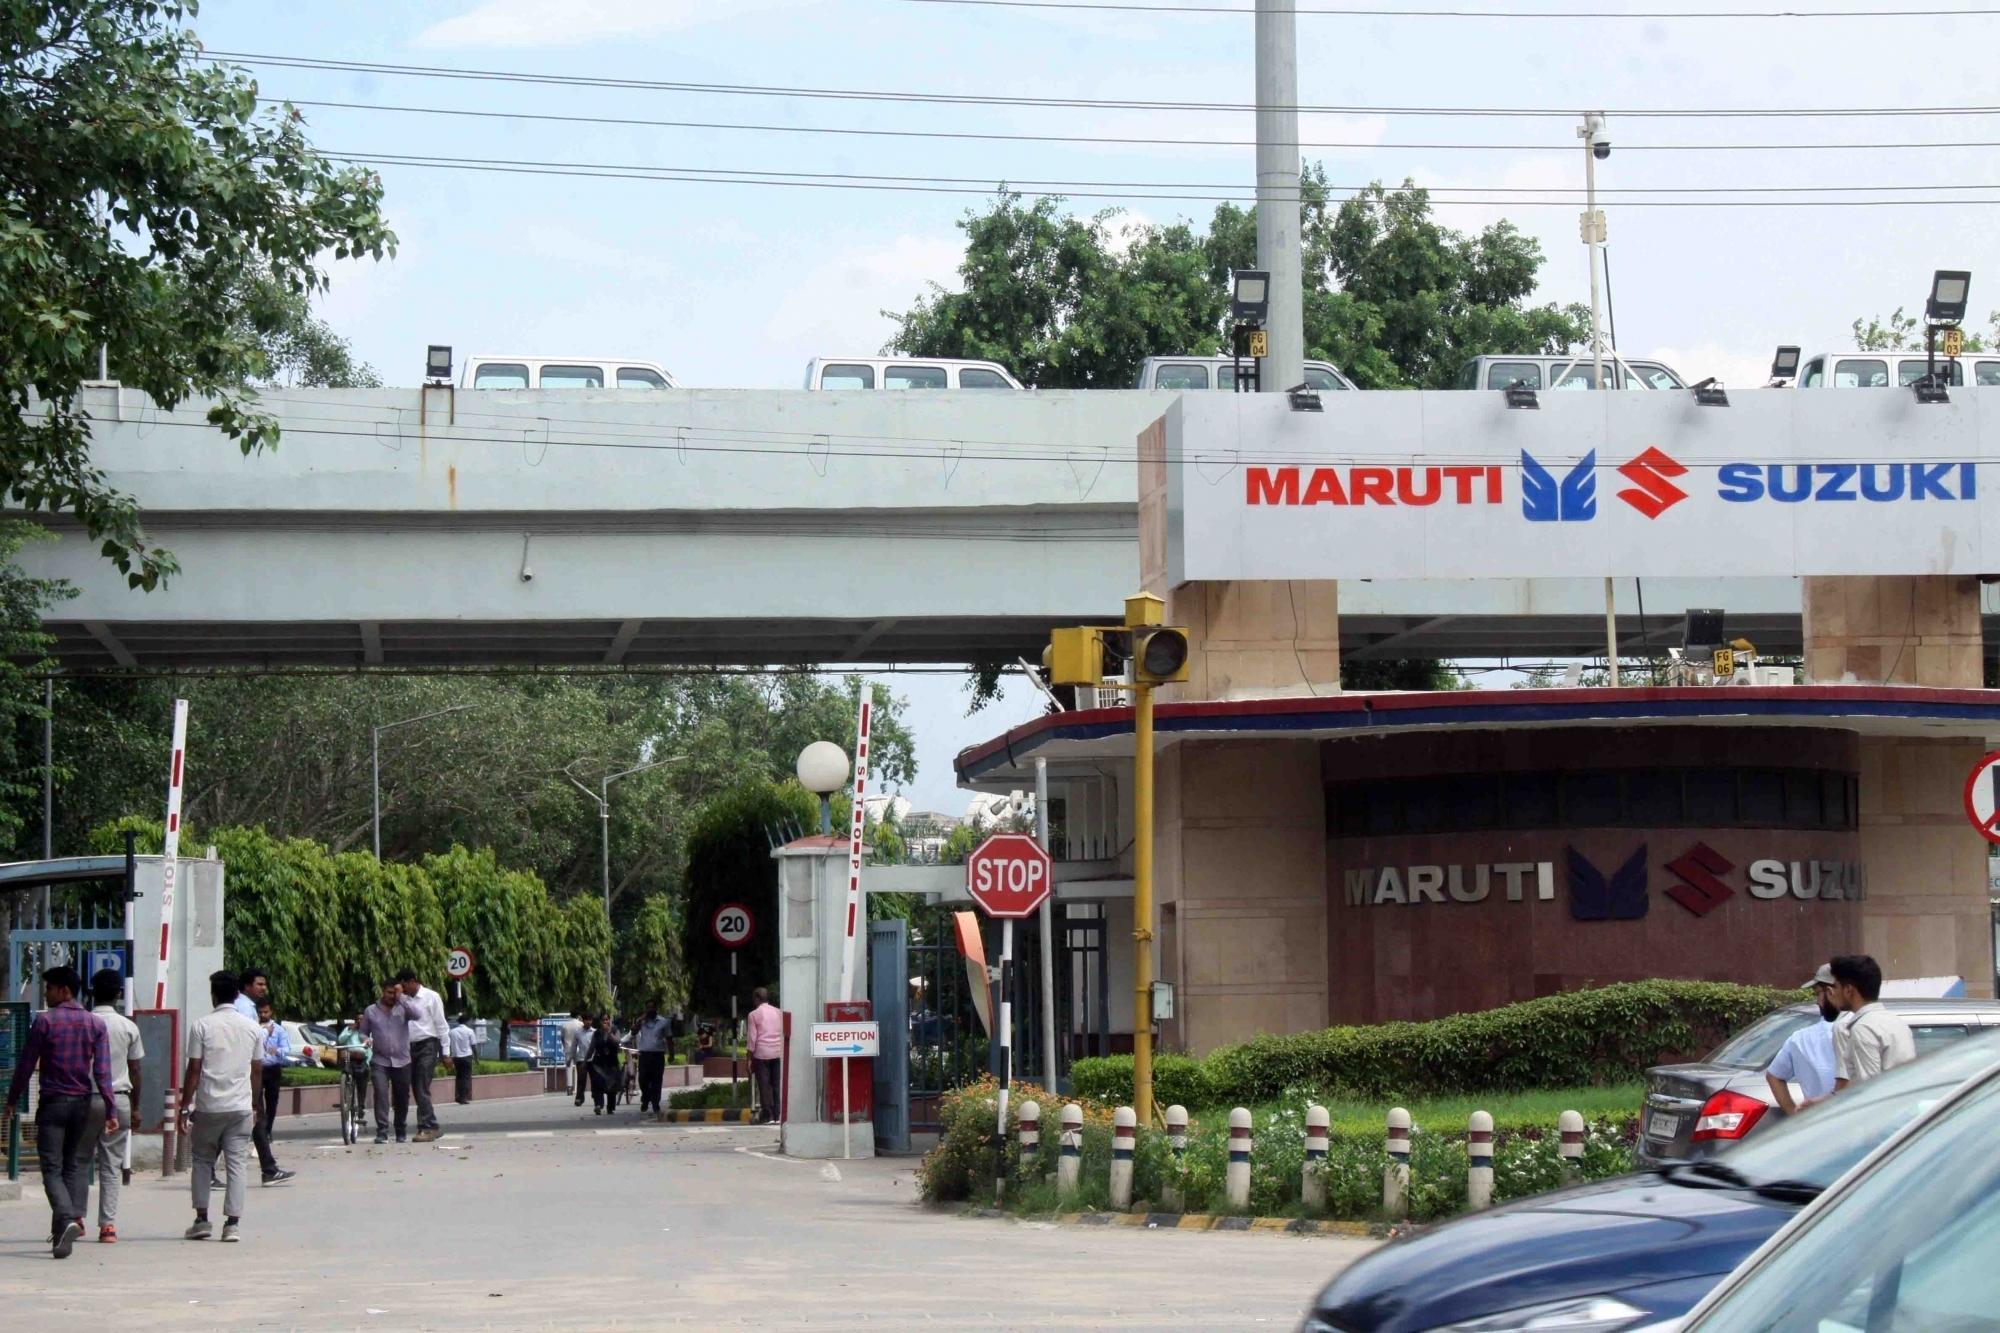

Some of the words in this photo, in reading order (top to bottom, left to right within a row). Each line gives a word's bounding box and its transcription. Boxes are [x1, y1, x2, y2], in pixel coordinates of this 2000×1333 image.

[1251, 333, 1263, 343] FG
[1947, 332, 1958, 342] FG
[1253, 346, 1264, 355] 04
[1946, 344, 1959, 354] 03
[1246, 466, 1503, 506] MARUTI
[1718, 462, 1976, 503] SUZUKI
[1717, 651, 1729, 661] FG
[1717, 664, 1730, 674] 06
[851, 766, 866, 870] STOP
[163, 852, 175, 905] STOP
[976, 858, 1043, 892] STOP
[1344, 861, 1555, 906] MARUTI
[720, 915, 745, 933] 20
[449, 956, 467, 970] 20
[815, 1031, 875, 1042] RECEPTION
